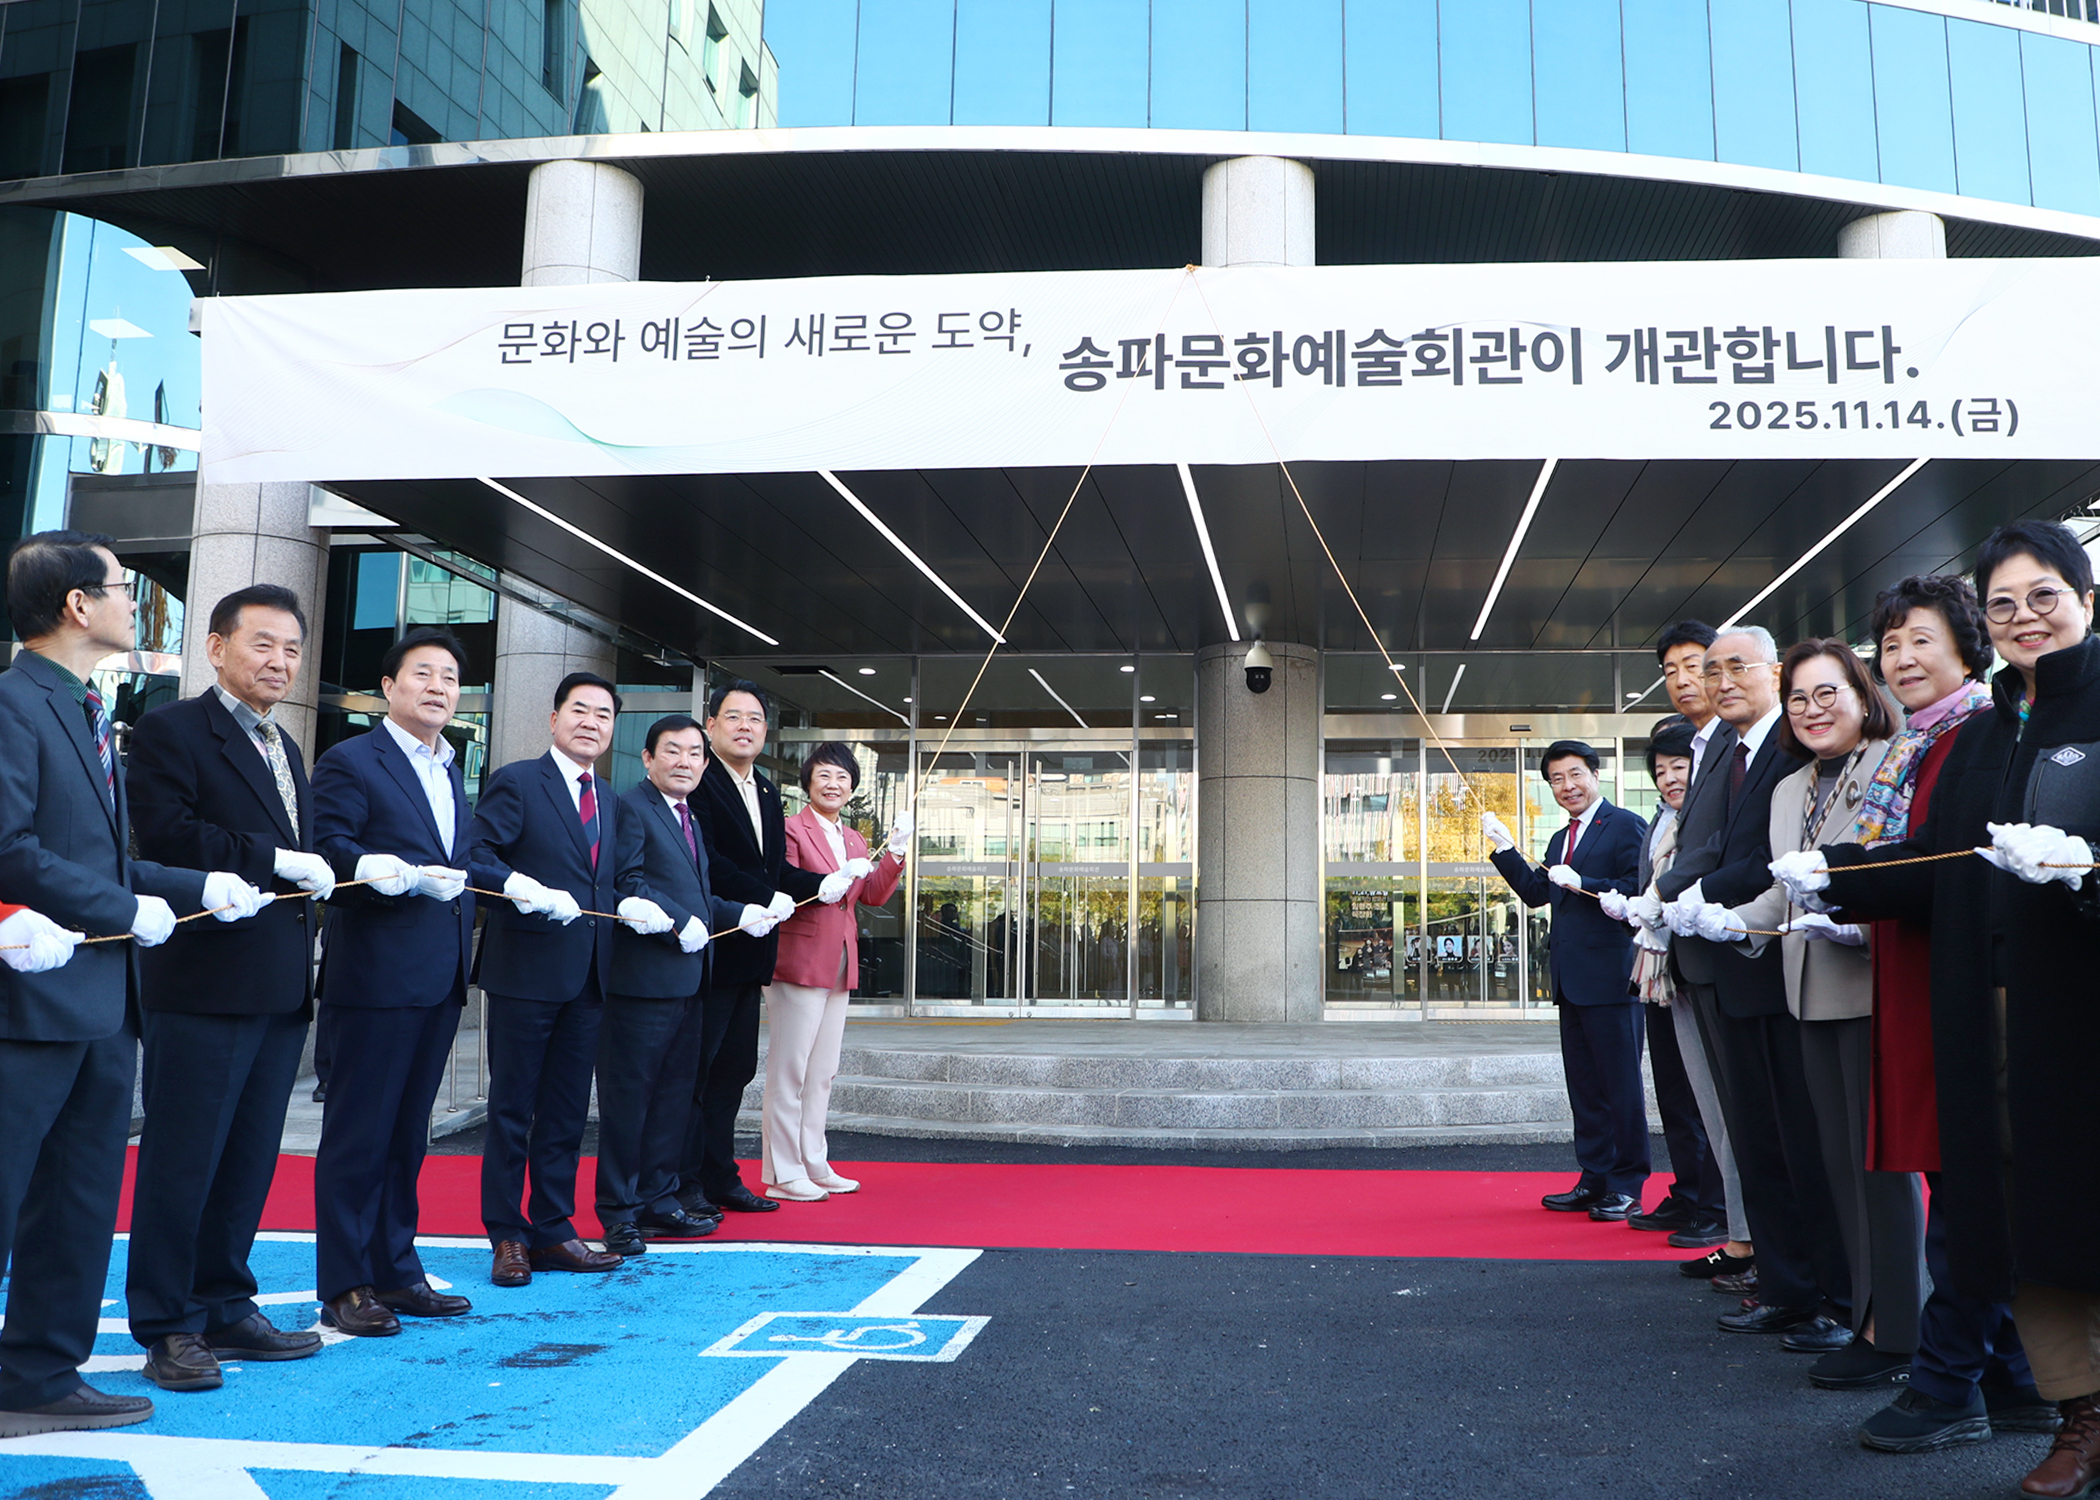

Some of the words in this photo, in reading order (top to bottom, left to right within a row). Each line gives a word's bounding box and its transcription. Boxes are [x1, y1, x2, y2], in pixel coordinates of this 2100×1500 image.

[498, 318, 626, 364] 문화와
[640, 314, 766, 361] 예술의
[784, 312, 917, 357] 새로운
[931, 308, 1031, 358] 도약,
[1058, 327, 1583, 392] 송파문화예술회관이
[1604, 325, 1919, 385] 개관합니다.
[1708, 398, 2019, 437] 2025.11.14.(금)
